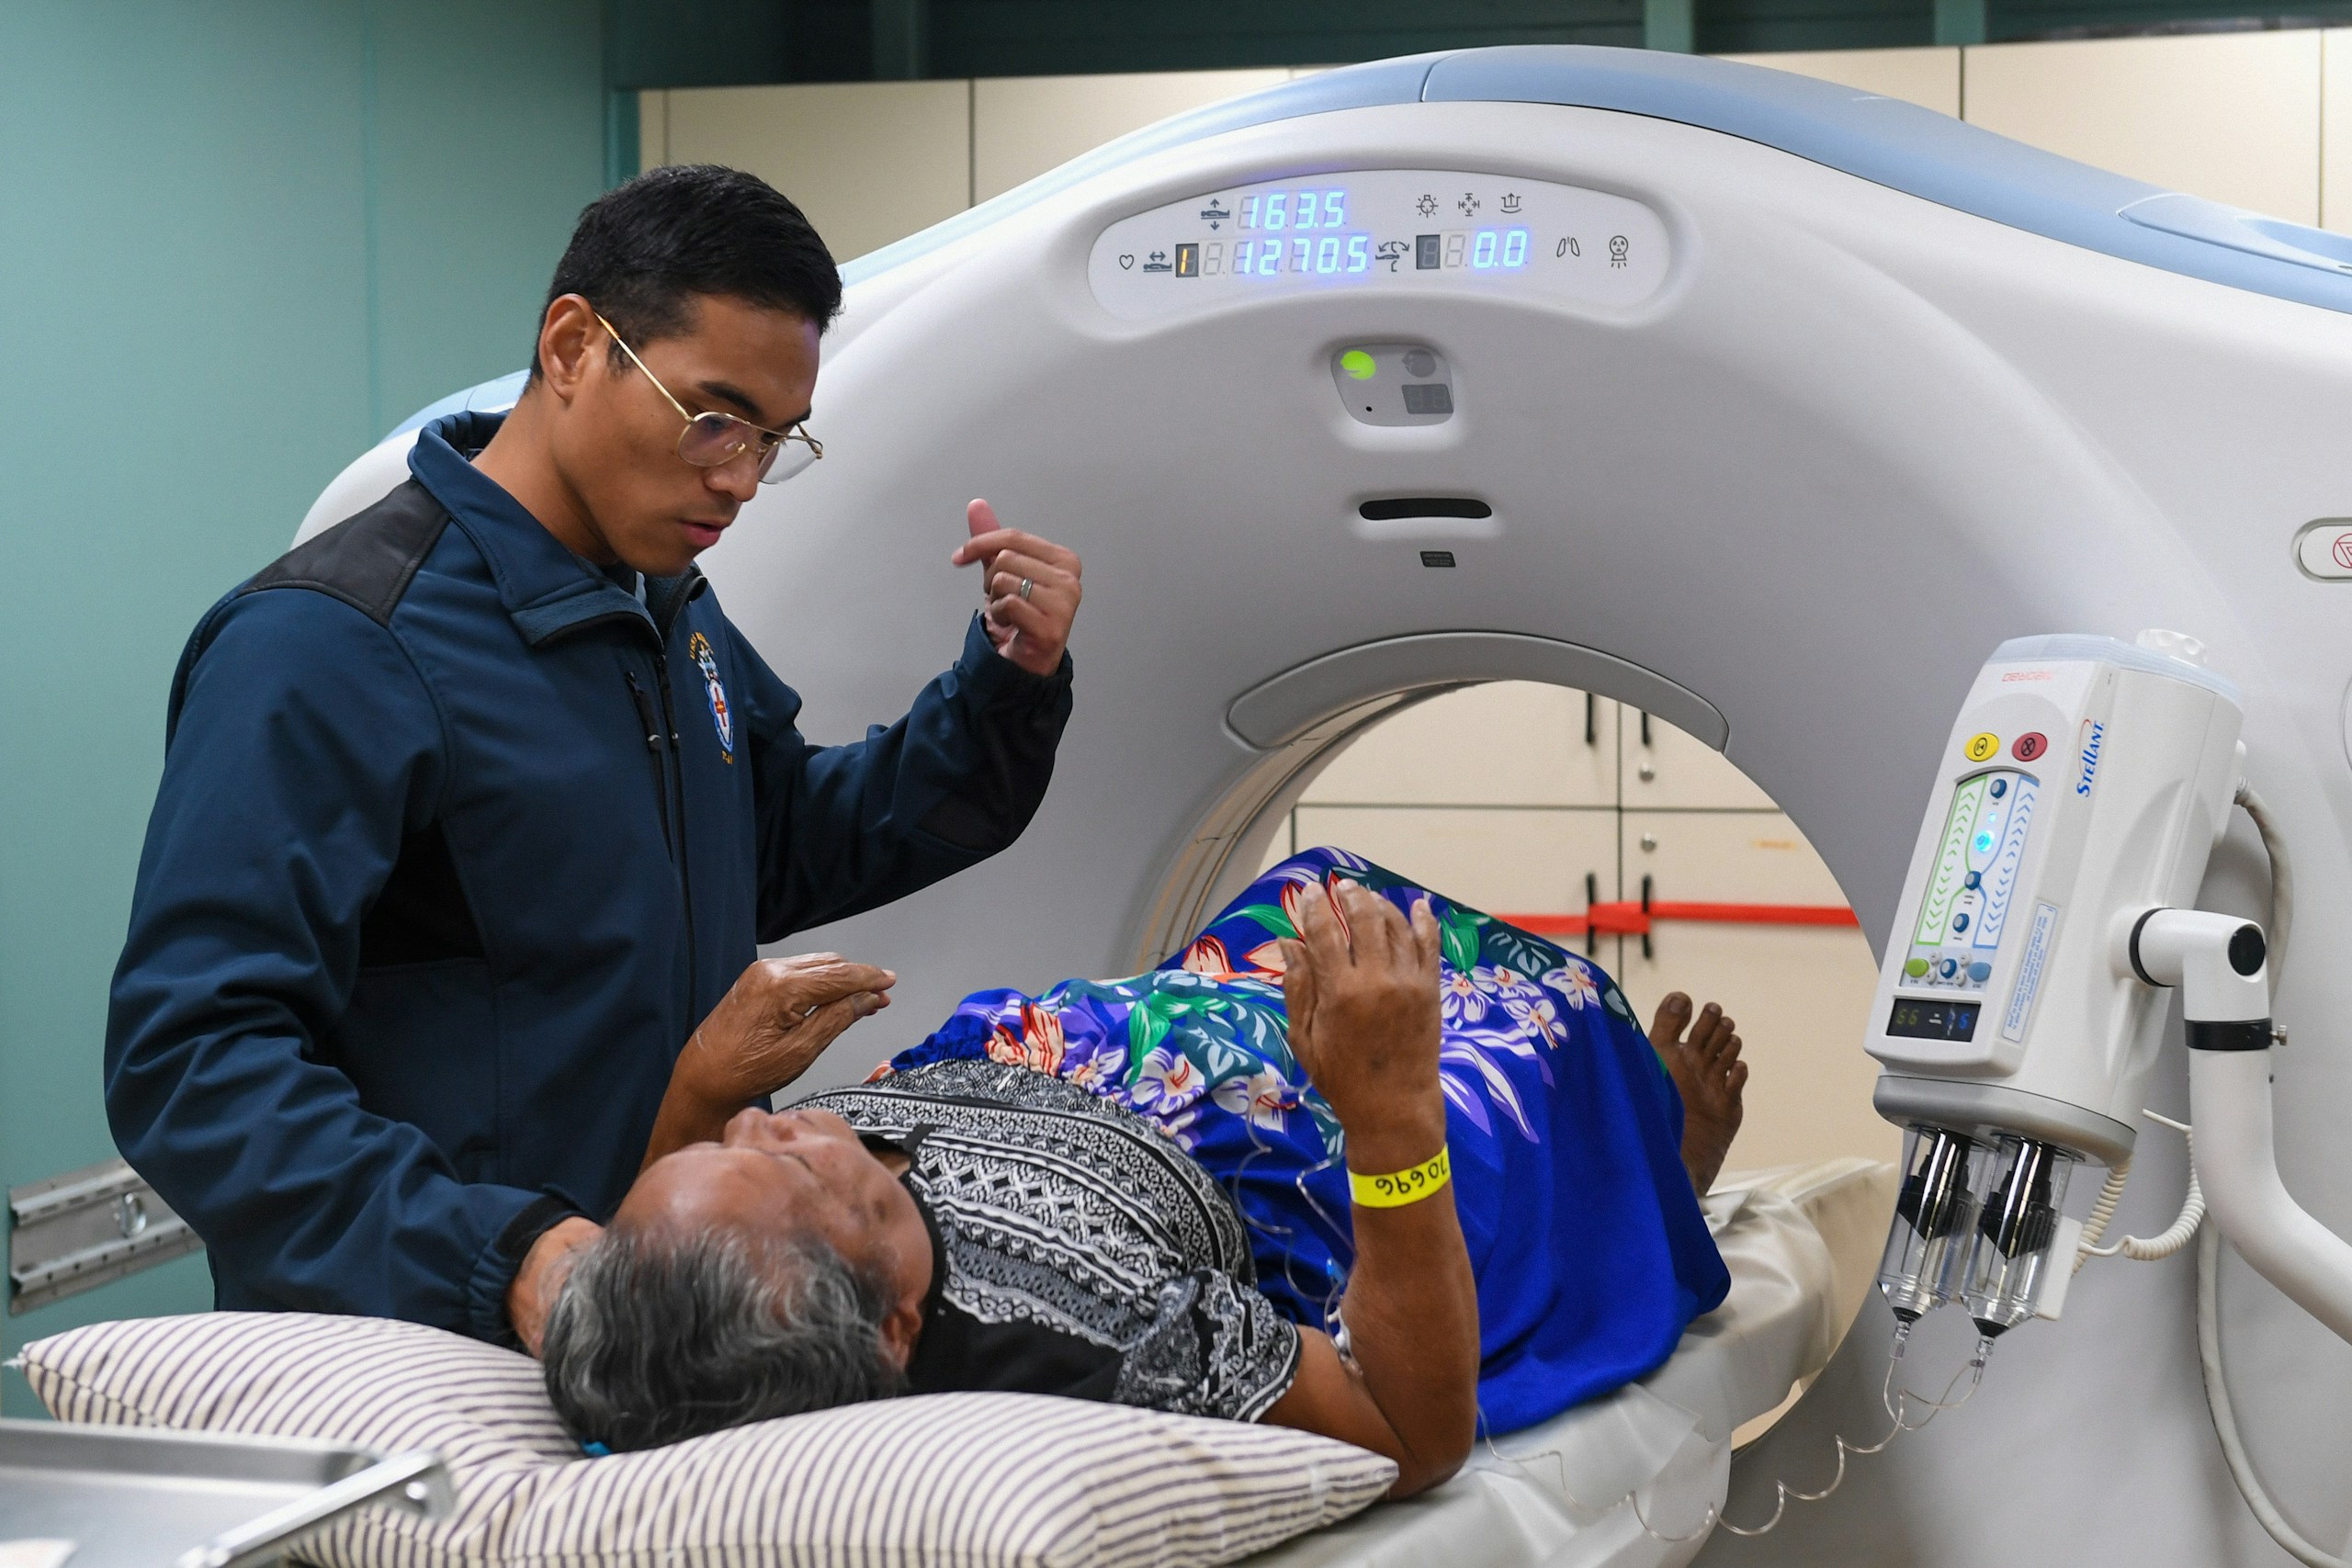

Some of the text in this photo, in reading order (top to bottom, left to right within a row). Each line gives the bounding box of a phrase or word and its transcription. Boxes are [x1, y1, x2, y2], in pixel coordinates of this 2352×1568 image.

[1250, 191, 1345, 231] 163.5
[1243, 236, 1368, 276] 1270.5
[1472, 230, 1528, 268] 0.0
